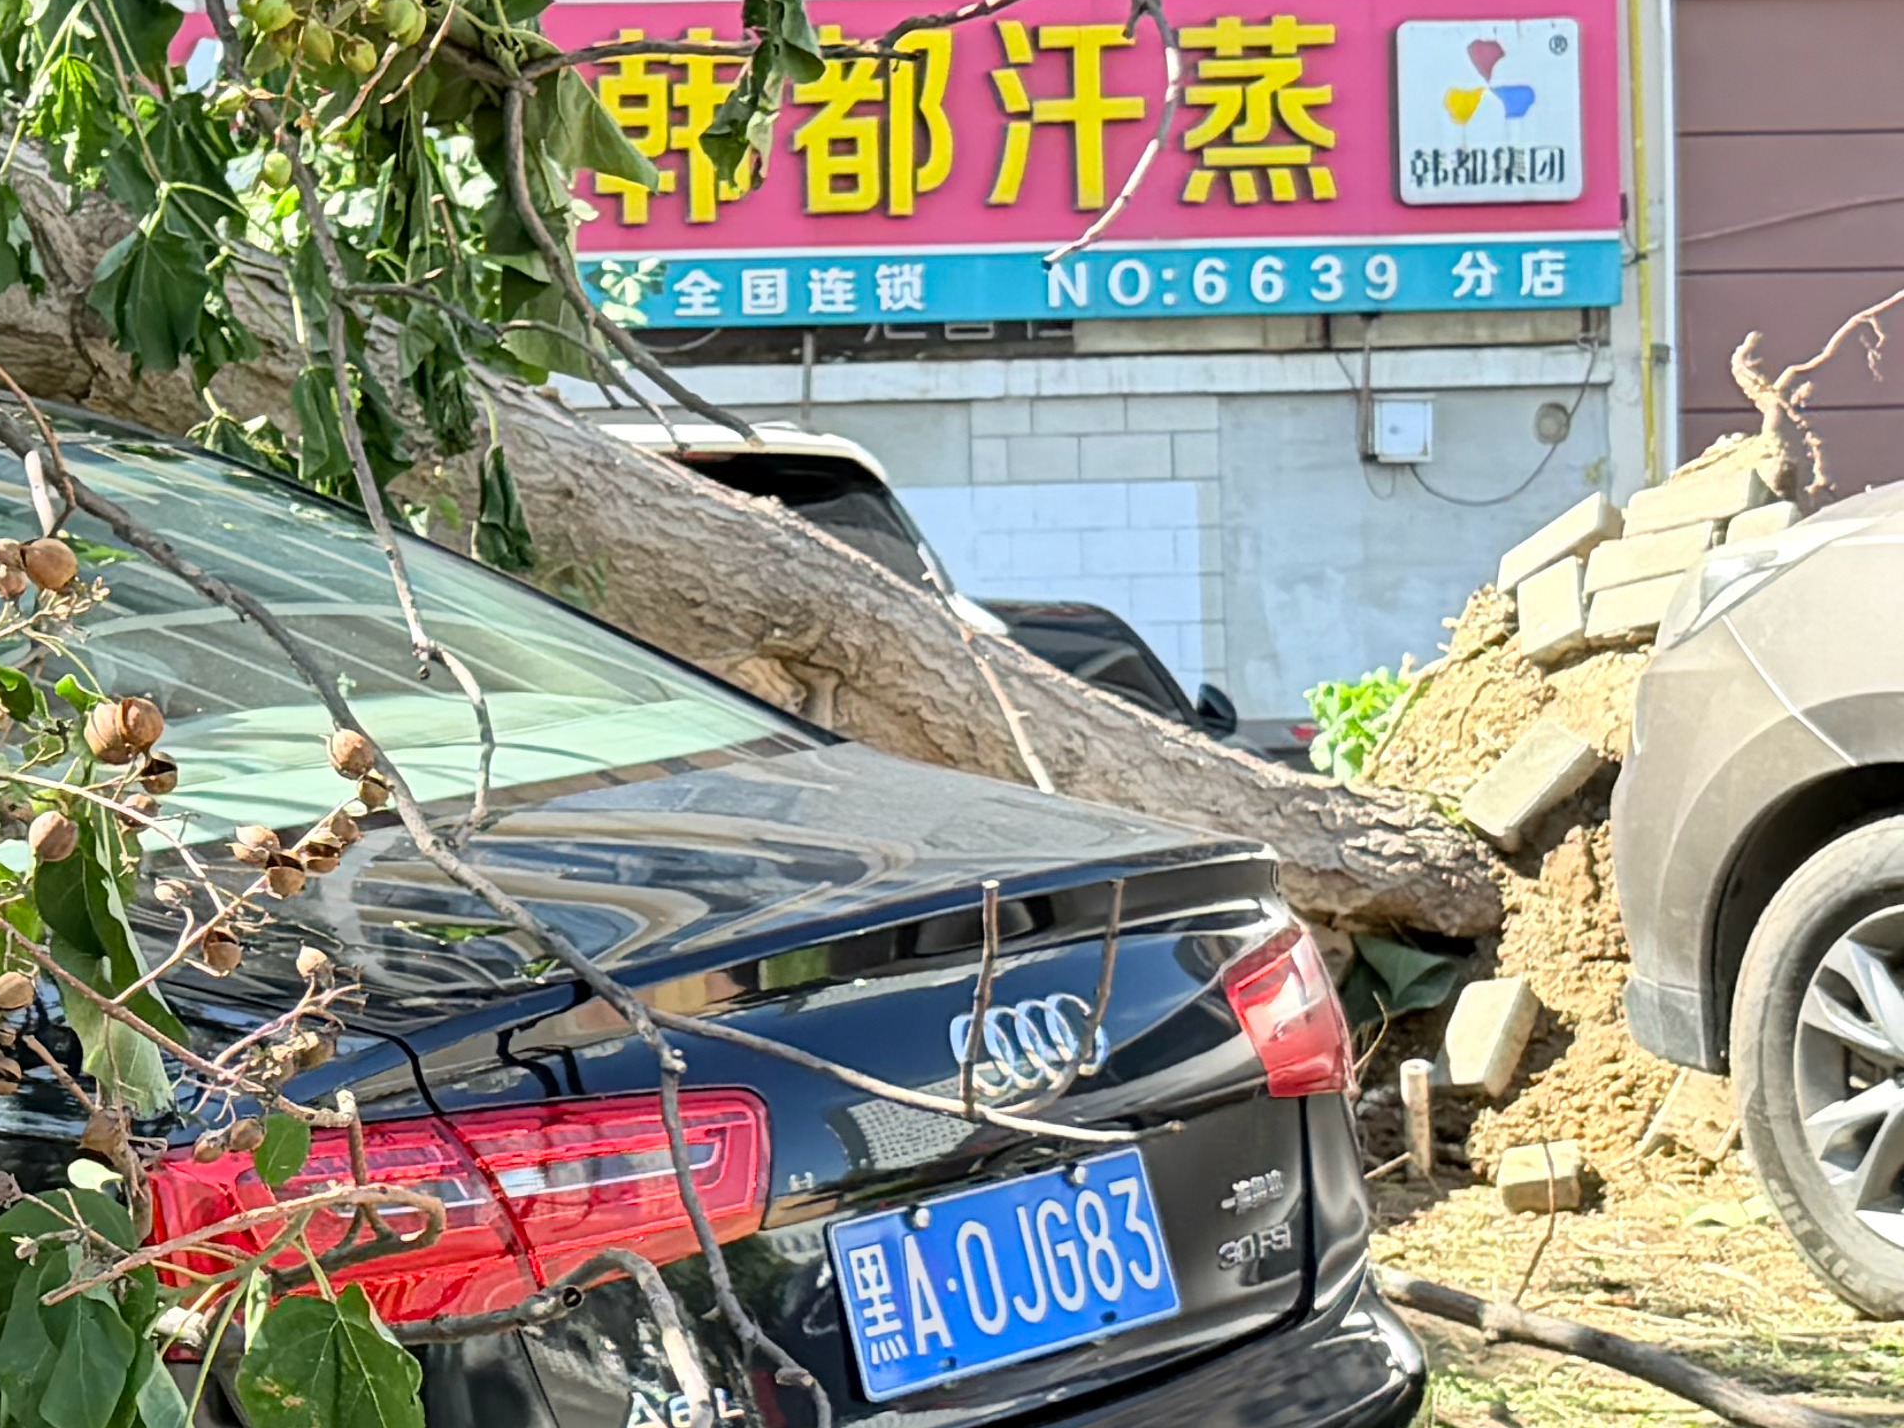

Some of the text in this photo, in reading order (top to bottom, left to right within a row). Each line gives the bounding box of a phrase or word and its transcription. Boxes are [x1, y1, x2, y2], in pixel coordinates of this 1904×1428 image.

[594, 15, 1337, 225] 韩都汗蒸
[1410, 146, 1565, 187] 韩都集团
[672, 250, 1567, 319] 全国连锁 NO:6639 分店
